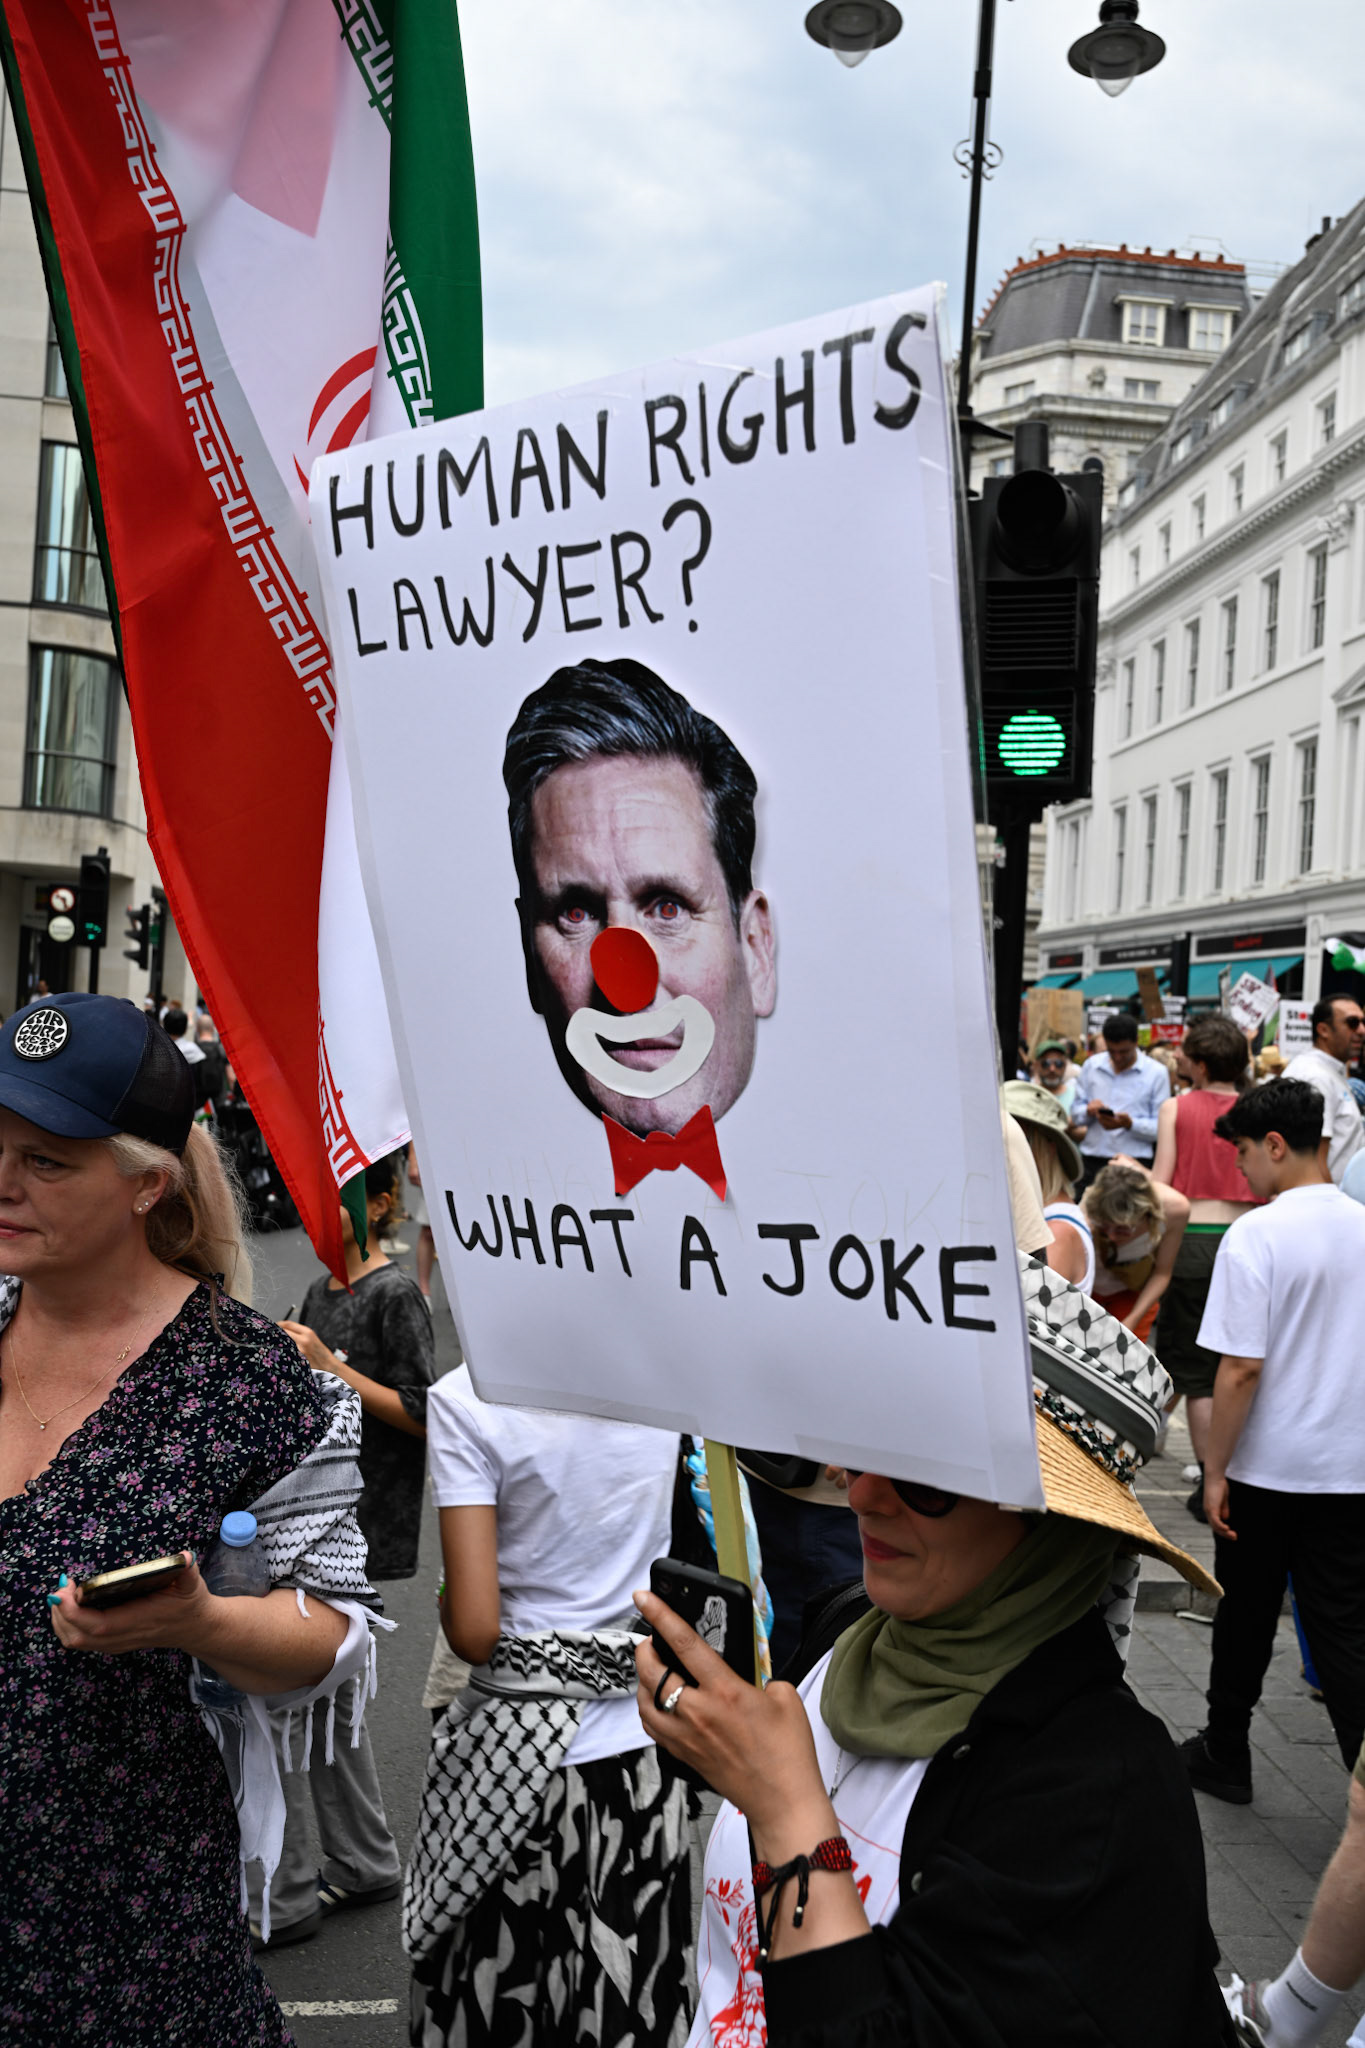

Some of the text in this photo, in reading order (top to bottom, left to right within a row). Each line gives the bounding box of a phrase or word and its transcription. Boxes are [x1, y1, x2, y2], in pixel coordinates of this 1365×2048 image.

[329, 410, 608, 558] HUMAN
[645, 313, 928, 488] RIGHTS
[347, 498, 712, 651] LAWYER?
[19, 1023, 65, 1044] CURL
[26, 1010, 64, 1026] RIP
[444, 1190, 635, 1278] WHAT
[680, 1215, 728, 1297] A
[757, 1223, 997, 1333] JOKE
